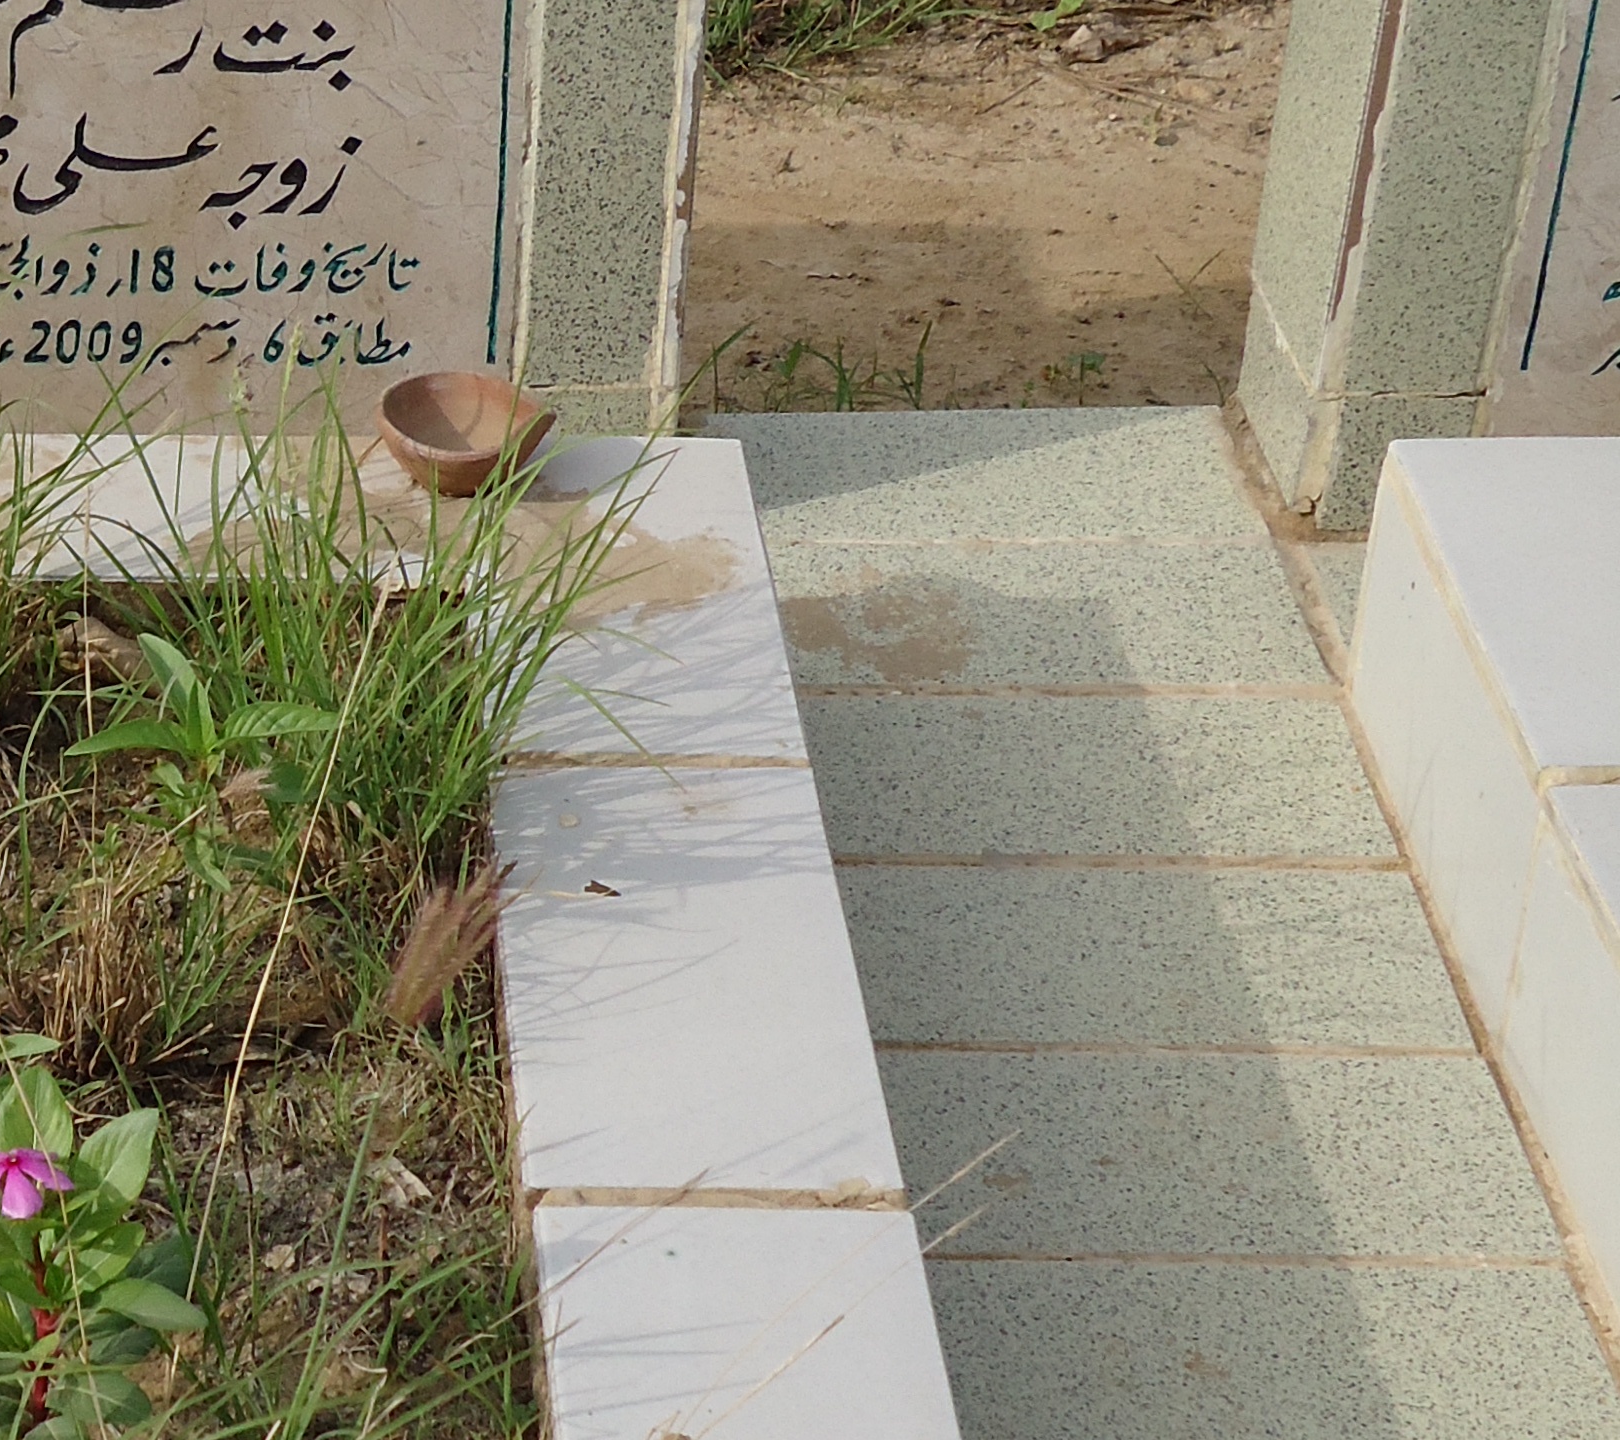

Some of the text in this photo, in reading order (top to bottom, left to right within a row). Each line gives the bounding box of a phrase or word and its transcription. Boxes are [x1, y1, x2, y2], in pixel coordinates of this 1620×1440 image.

[212, 20, 356, 92] بنت
[12, 112, 220, 216] علی
[198, 136, 363, 231] زوجہ
[194, 242, 316, 298] وفات
[323, 241, 421, 294] تاریخ
[140, 317, 241, 375] دسمبر
[297, 312, 412, 366] مطابق
